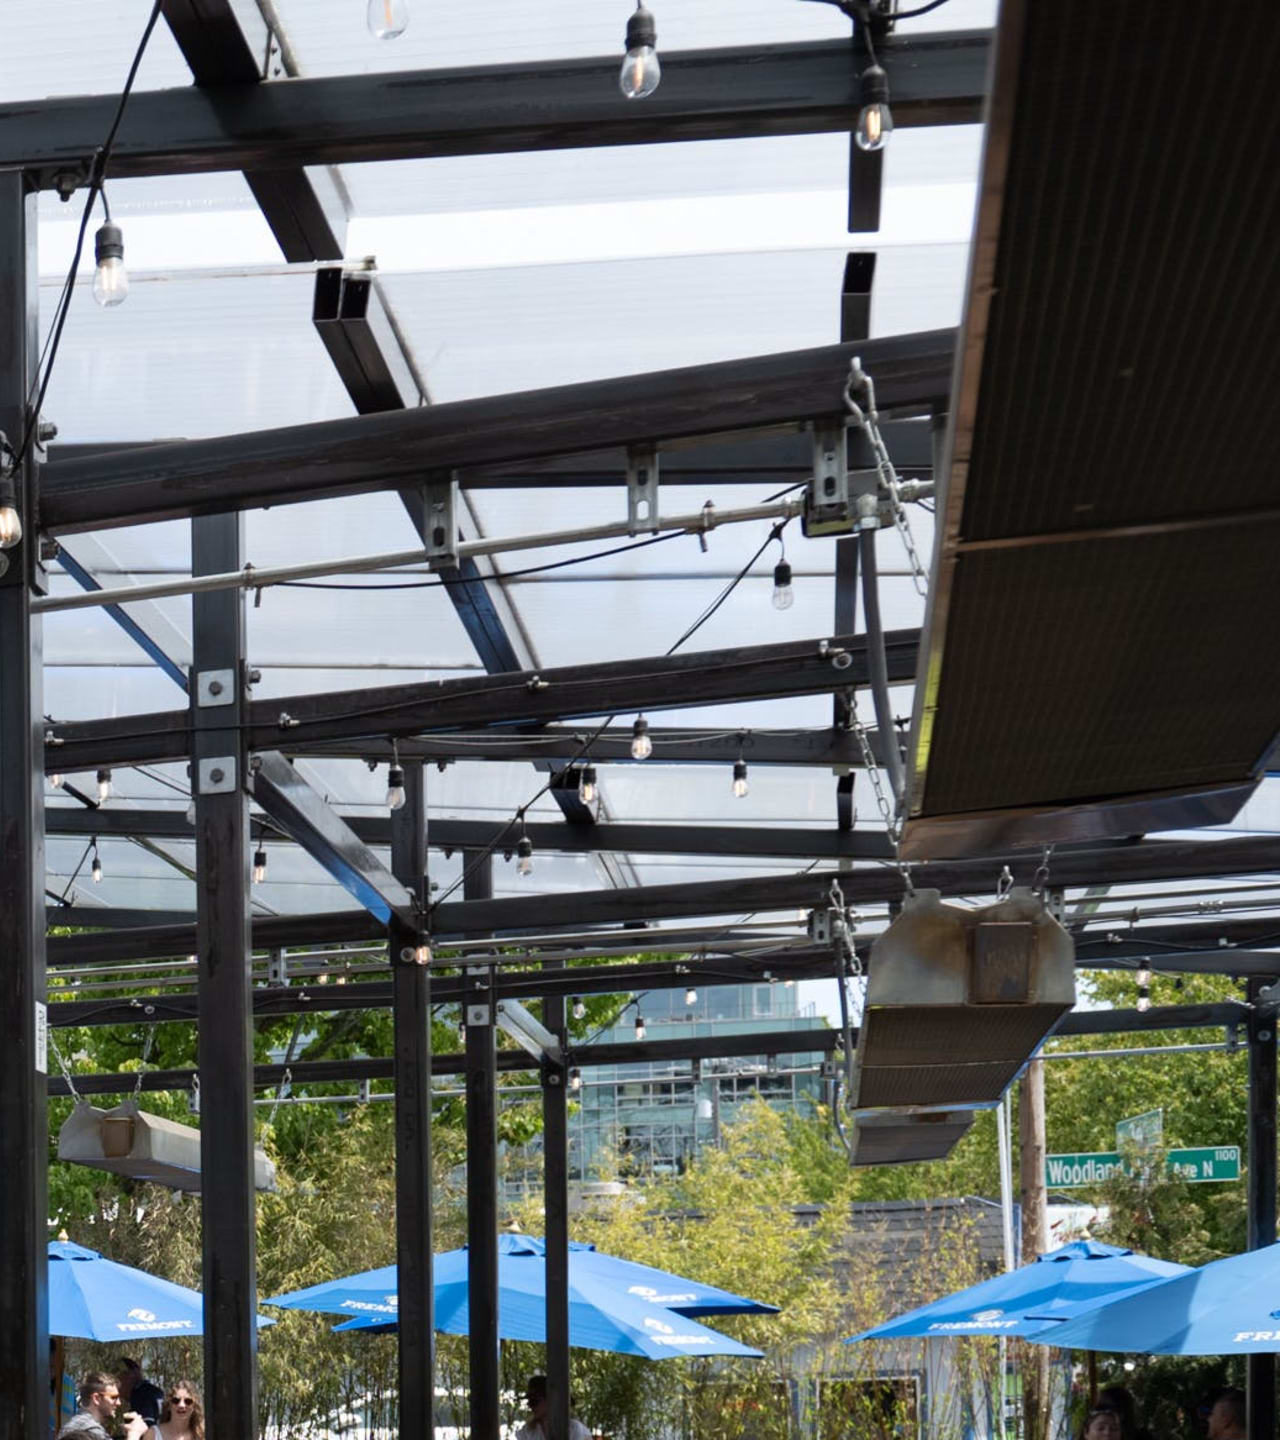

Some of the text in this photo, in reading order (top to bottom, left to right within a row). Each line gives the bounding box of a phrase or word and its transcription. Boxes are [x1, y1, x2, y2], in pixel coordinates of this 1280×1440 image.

[1215, 1149, 1237, 1161] 1100
[1048, 1160, 1124, 1185] Woodland
[1172, 1160, 1198, 1178] Ave
[1202, 1160, 1214, 1178] N
